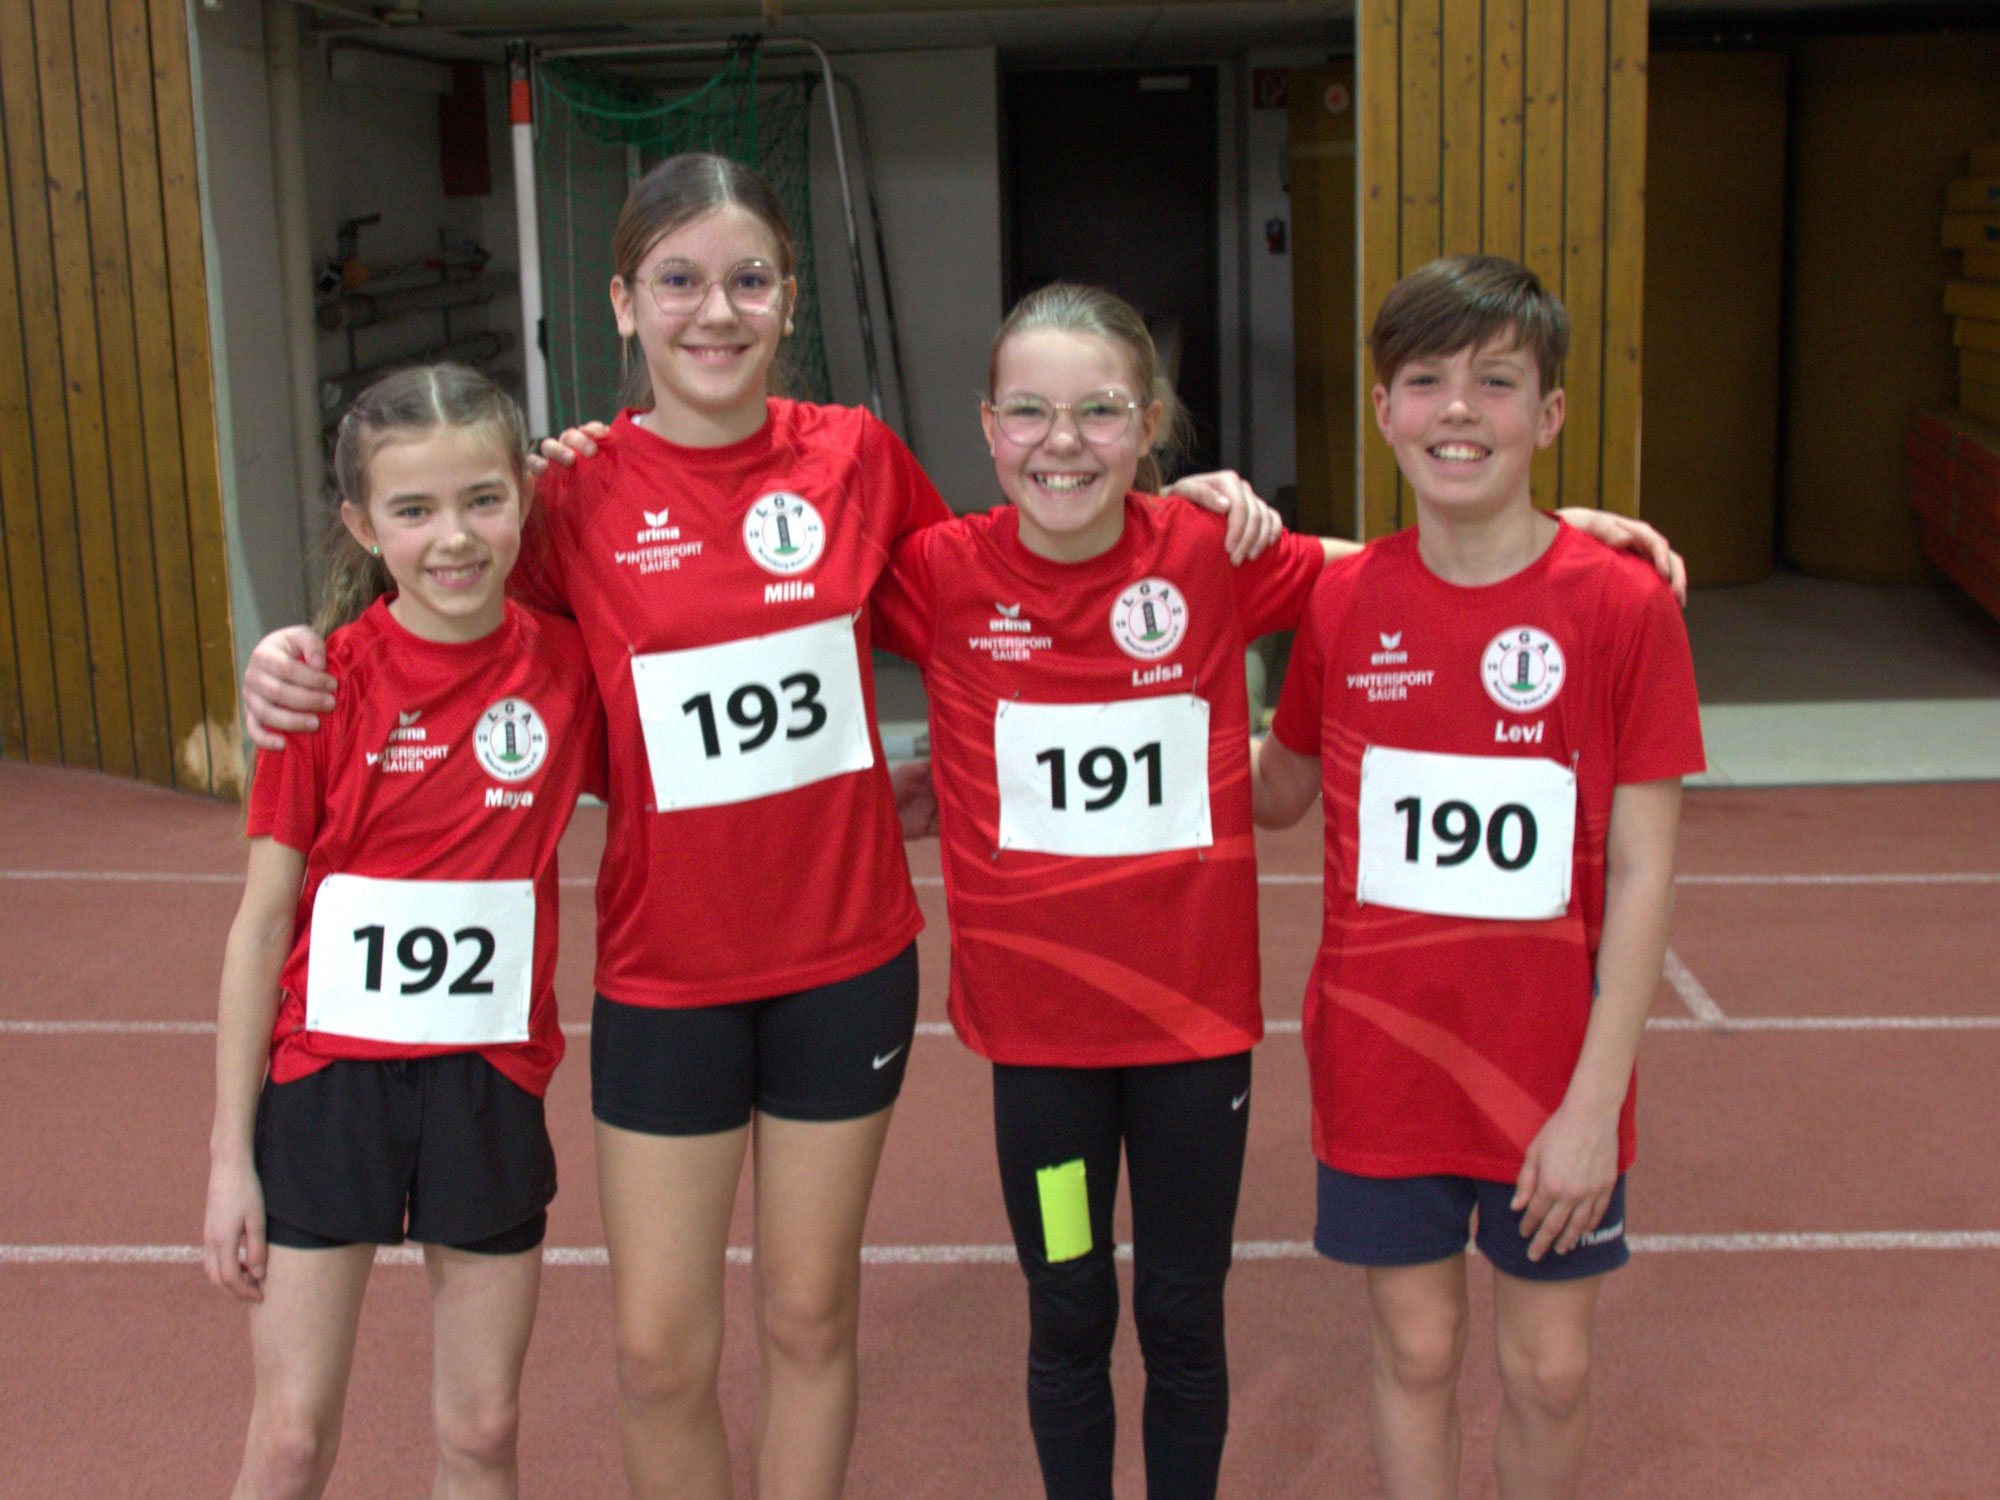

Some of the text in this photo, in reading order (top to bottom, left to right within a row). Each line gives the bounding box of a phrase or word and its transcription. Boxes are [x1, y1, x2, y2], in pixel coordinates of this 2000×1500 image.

[637, 526, 680, 544] erima
[640, 559, 680, 574] SAUER
[764, 580, 815, 604] Milla
[989, 618, 1031, 633] erima
[991, 649, 1031, 661] SAUER
[1371, 650, 1408, 666] erima
[1132, 663, 1183, 687] Luisa
[1367, 685, 1408, 702] SAUER
[681, 670, 828, 760] 193
[1495, 720, 1544, 744] Levi
[382, 758, 425, 773] SAUER
[1035, 740, 1163, 812] 191
[485, 788, 534, 811] Maya
[1394, 795, 1538, 873] 190
[353, 923, 496, 996] 192
